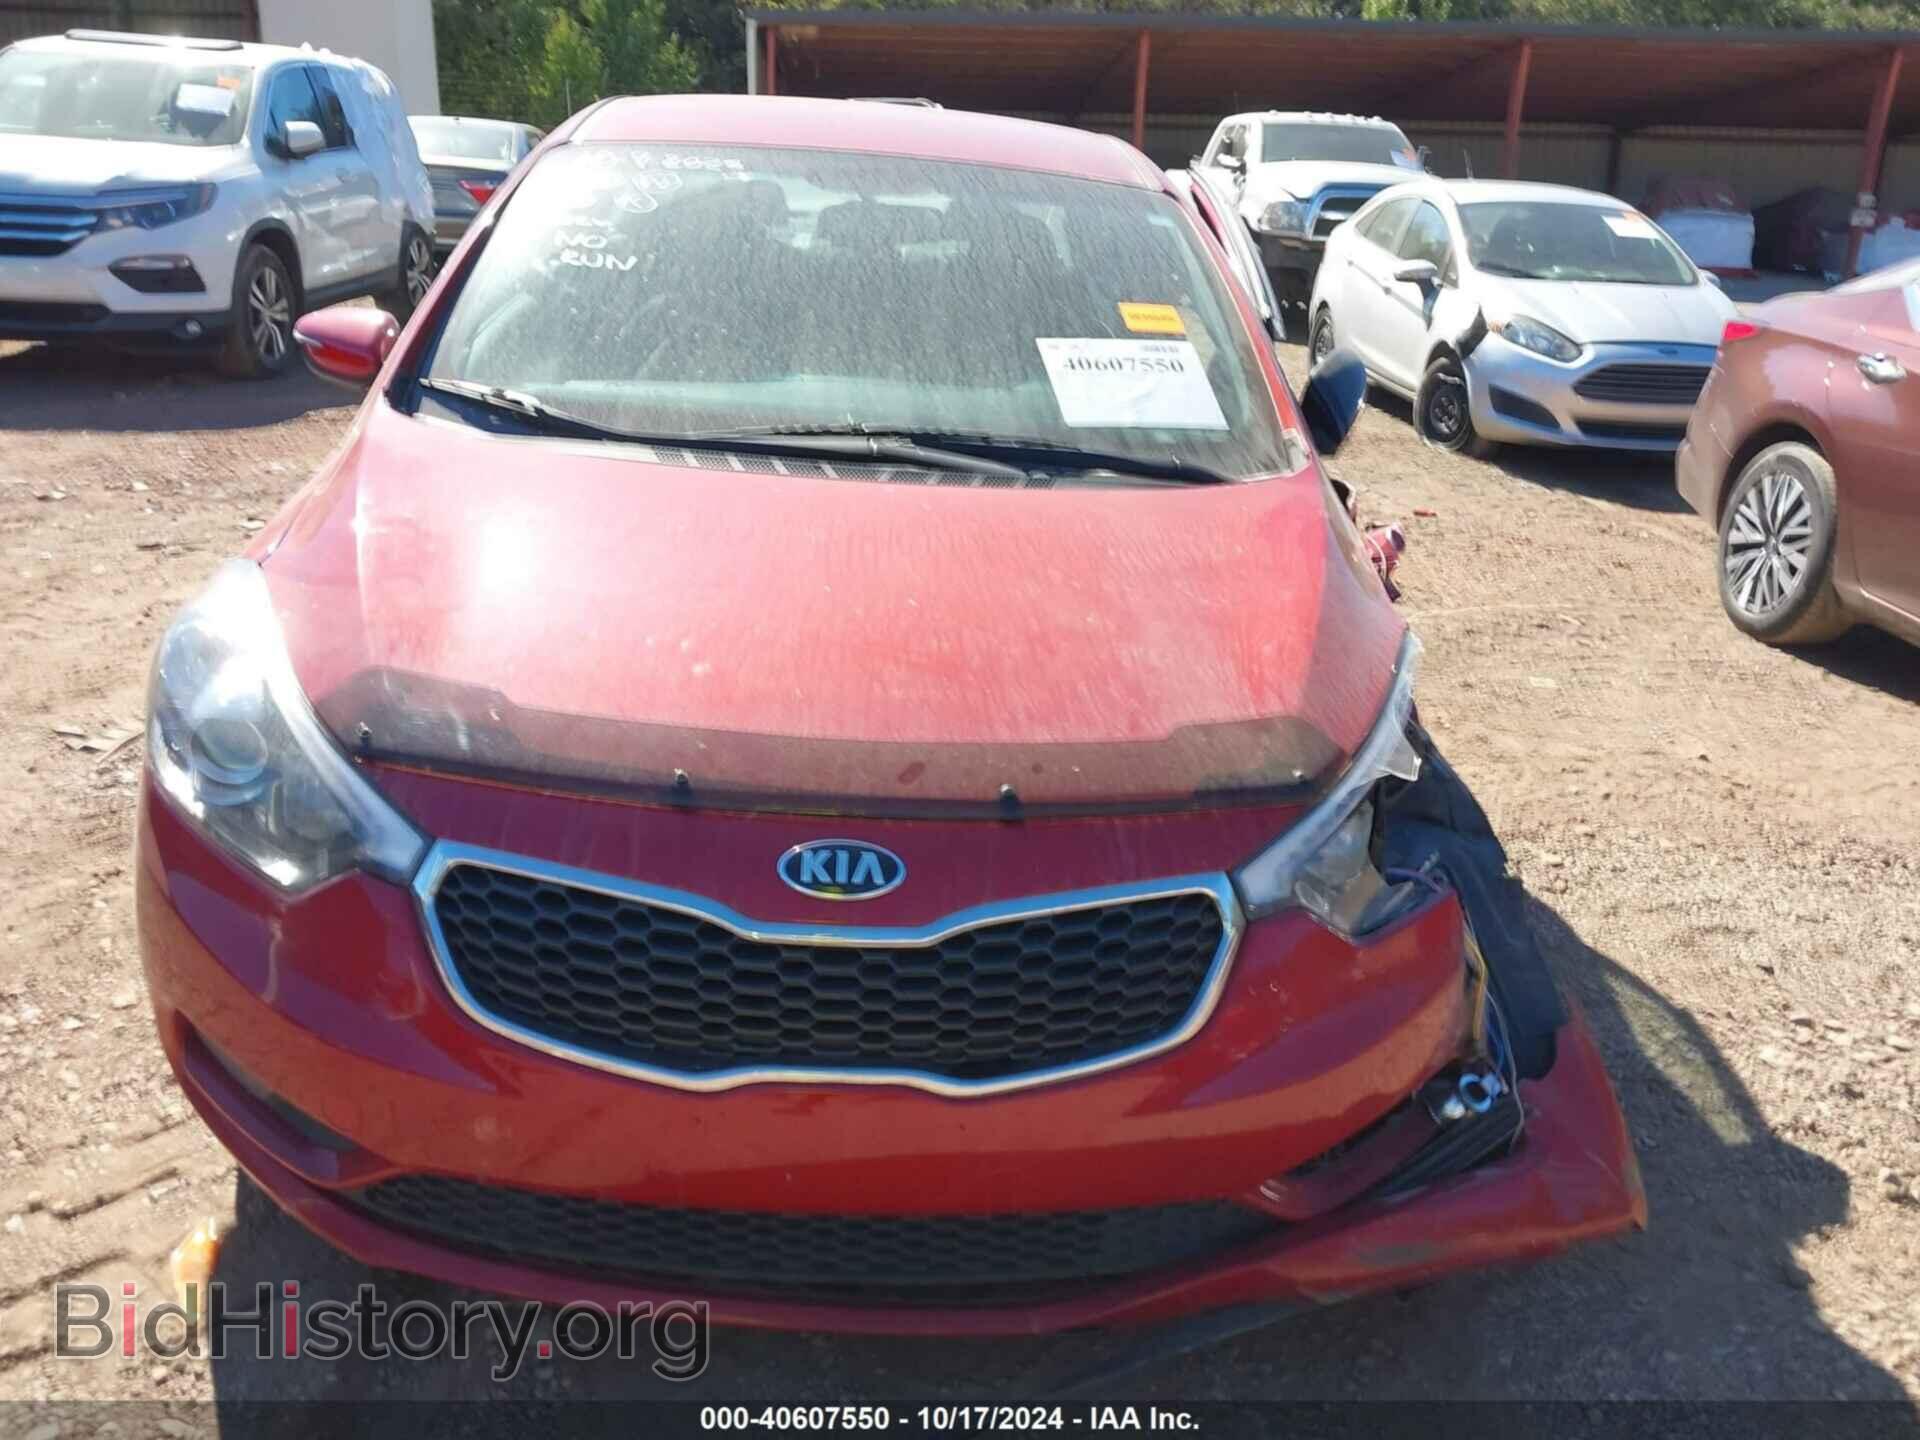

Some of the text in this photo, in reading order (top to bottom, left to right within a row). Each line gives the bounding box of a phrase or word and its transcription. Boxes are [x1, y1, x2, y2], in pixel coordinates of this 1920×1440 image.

[559, 248, 639, 271] RUN
[1064, 357, 1185, 374] 40607550
[800, 848, 886, 886] KIA
